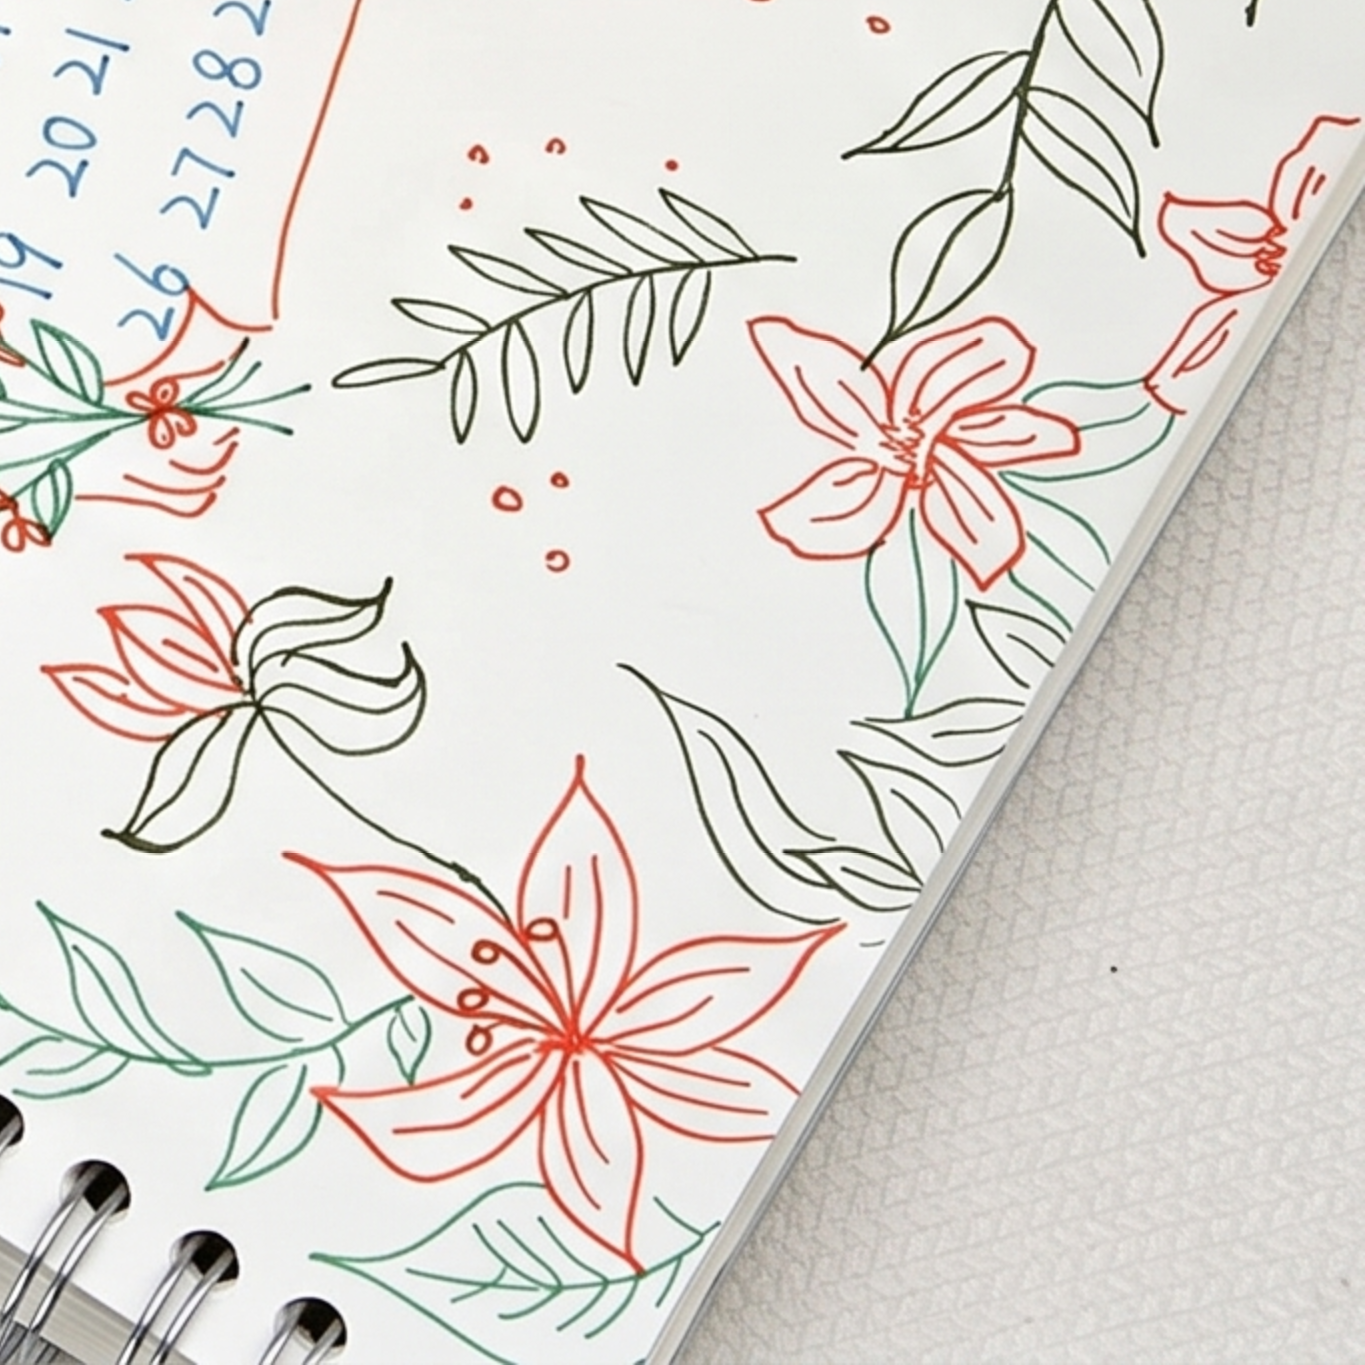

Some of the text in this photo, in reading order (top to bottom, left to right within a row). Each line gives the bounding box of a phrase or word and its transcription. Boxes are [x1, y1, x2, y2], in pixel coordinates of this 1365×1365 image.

[52, 27, 131, 97] 21
[185, 48, 263, 139] 28
[24, 115, 98, 199] 20
[158, 146, 237, 231] 27
[114, 252, 191, 342] 26
